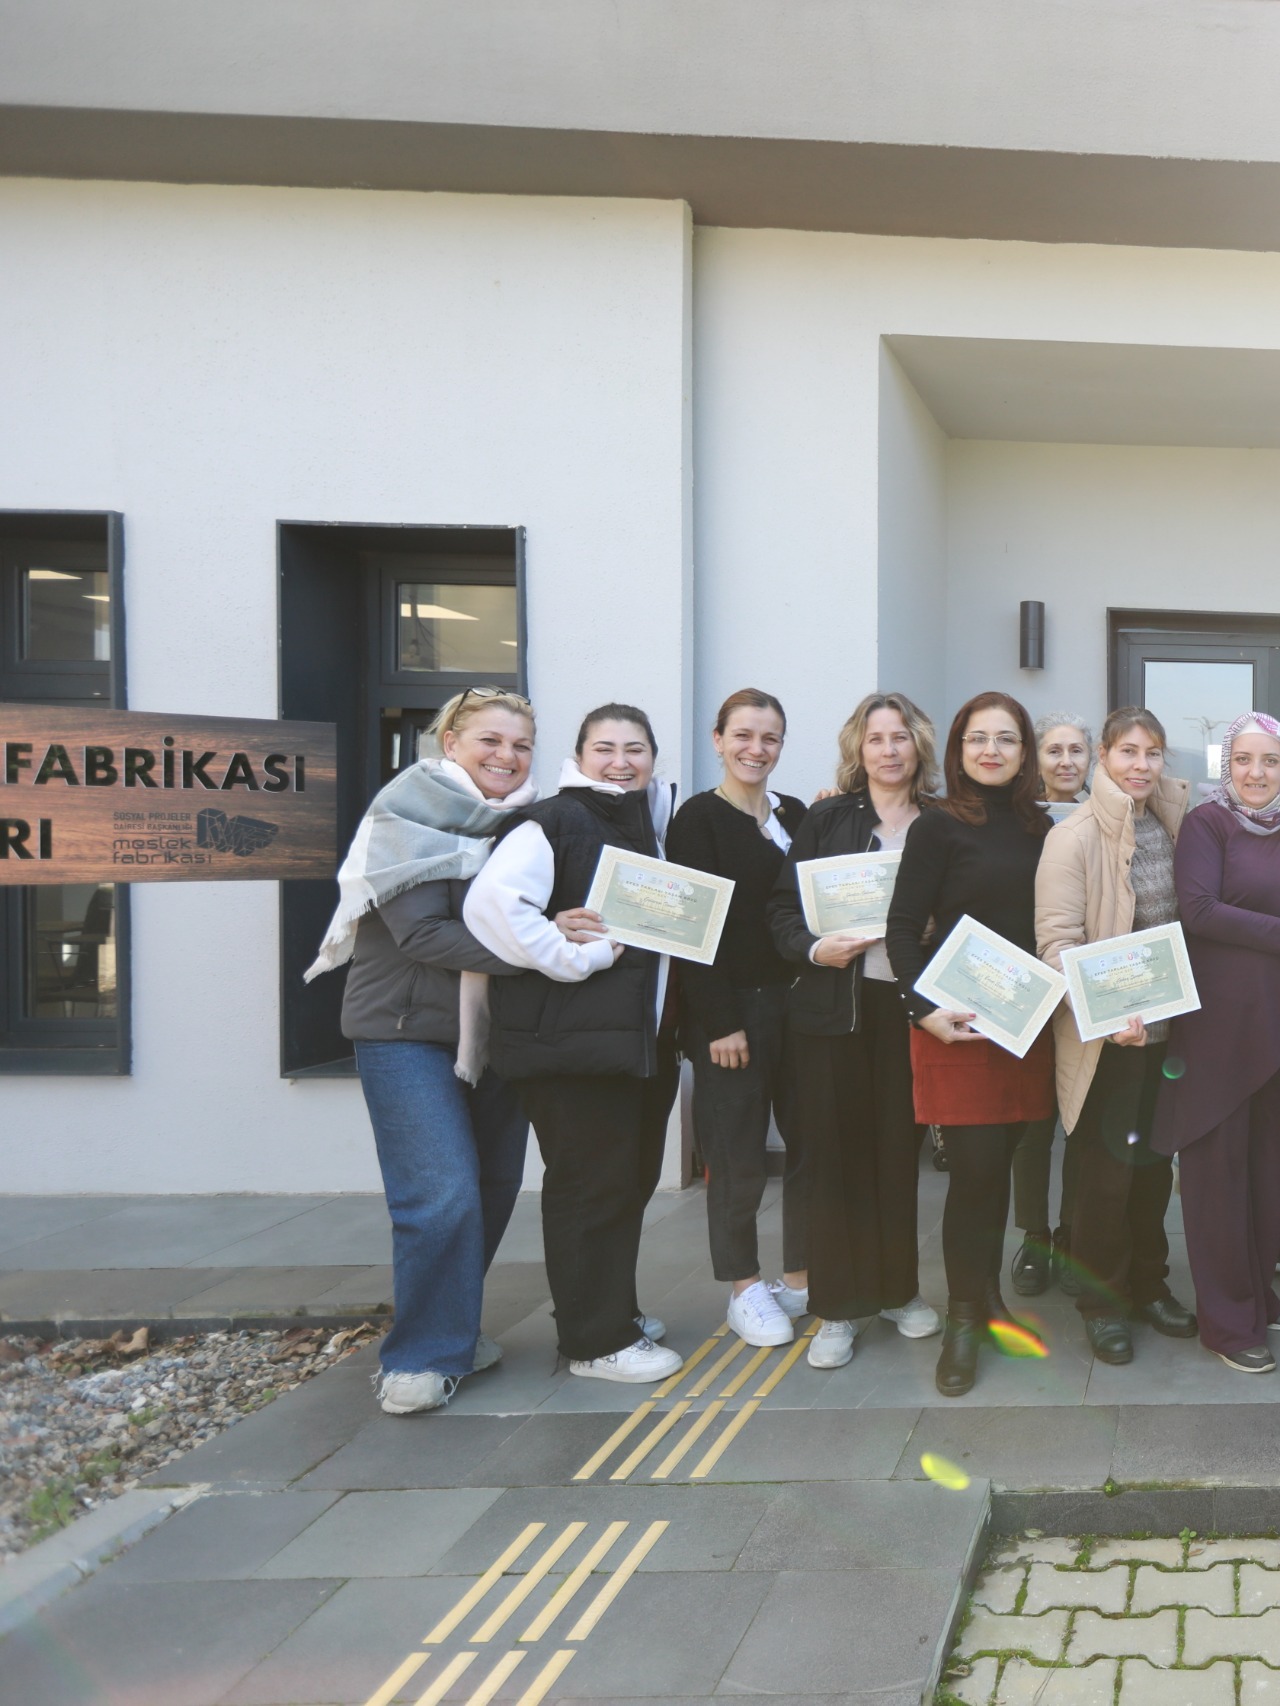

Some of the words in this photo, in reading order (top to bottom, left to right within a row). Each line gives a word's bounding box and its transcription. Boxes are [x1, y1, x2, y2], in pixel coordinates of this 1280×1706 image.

[5, 736, 306, 793] FABRİKASI
[113, 811, 145, 821] SOSYAL
[149, 812, 191, 821] PROJELER
[113, 836, 192, 850] meslek
